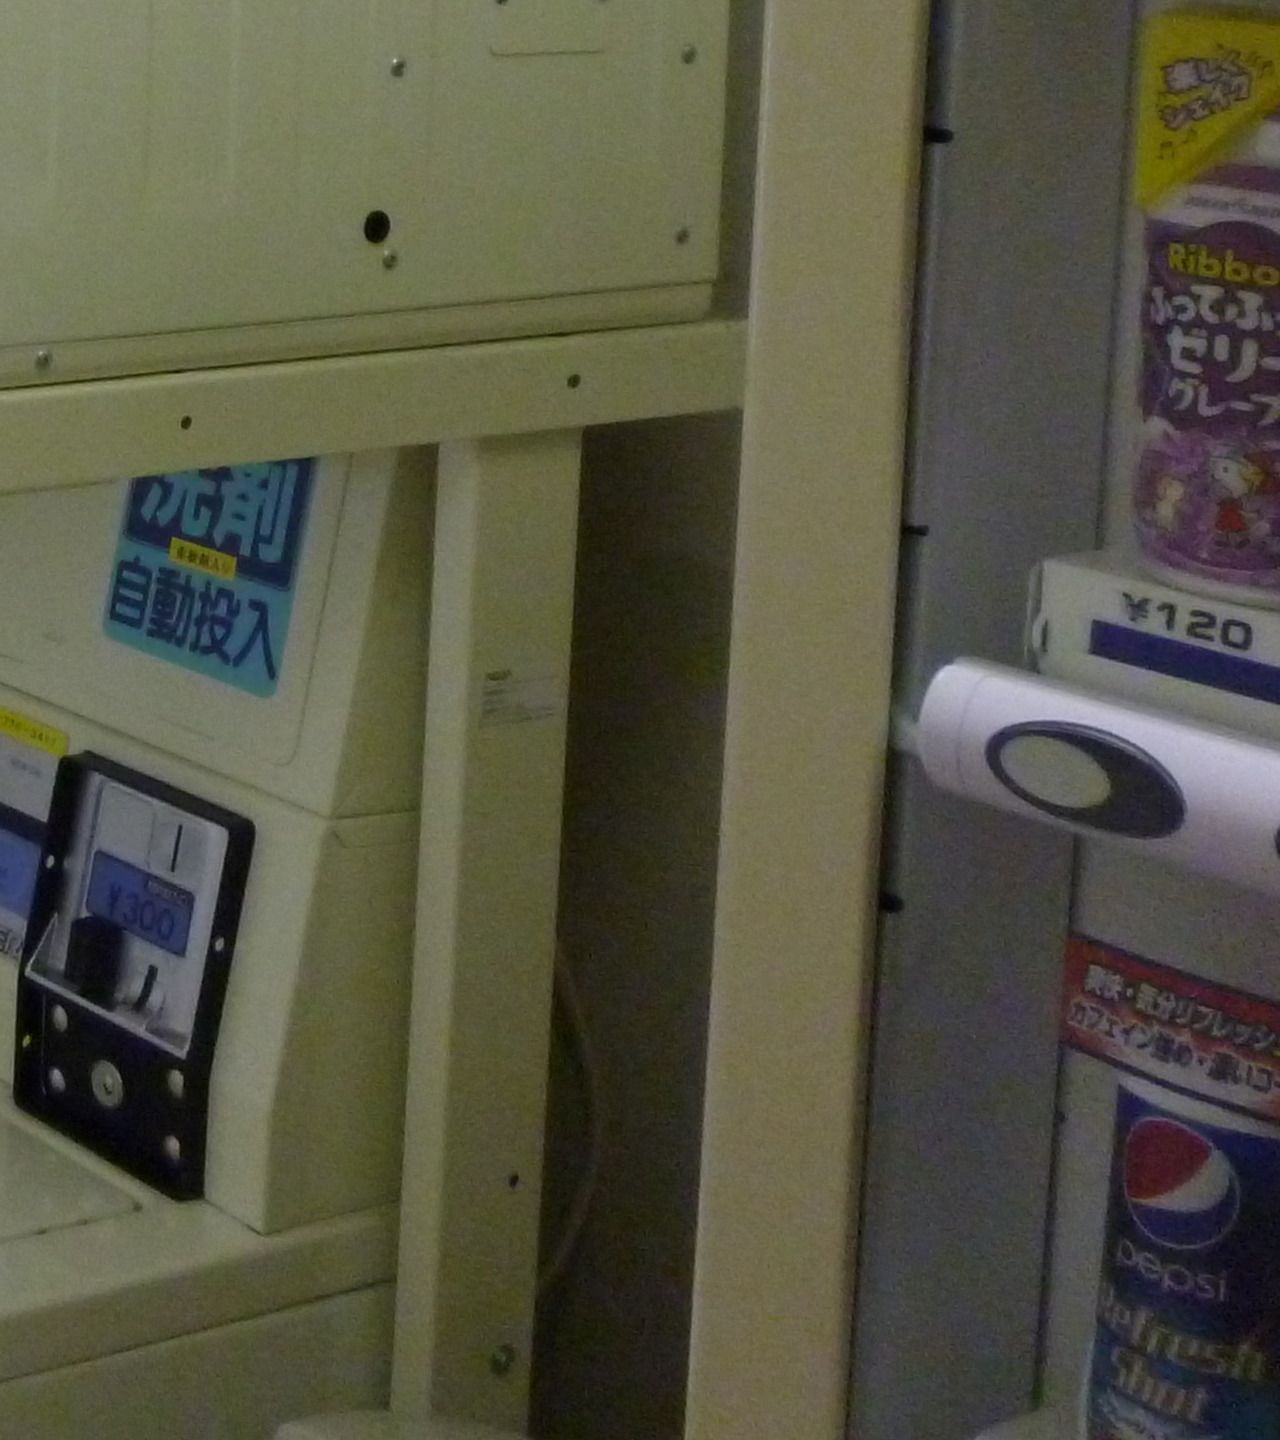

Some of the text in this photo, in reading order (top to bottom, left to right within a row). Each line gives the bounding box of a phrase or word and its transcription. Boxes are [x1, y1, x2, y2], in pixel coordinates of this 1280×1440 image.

[109, 555, 277, 681] 自動投入
[1122, 592, 1253, 652] ¥120
[107, 886, 176, 943] ¥300
[1118, 1238, 1227, 1302] pepsi
